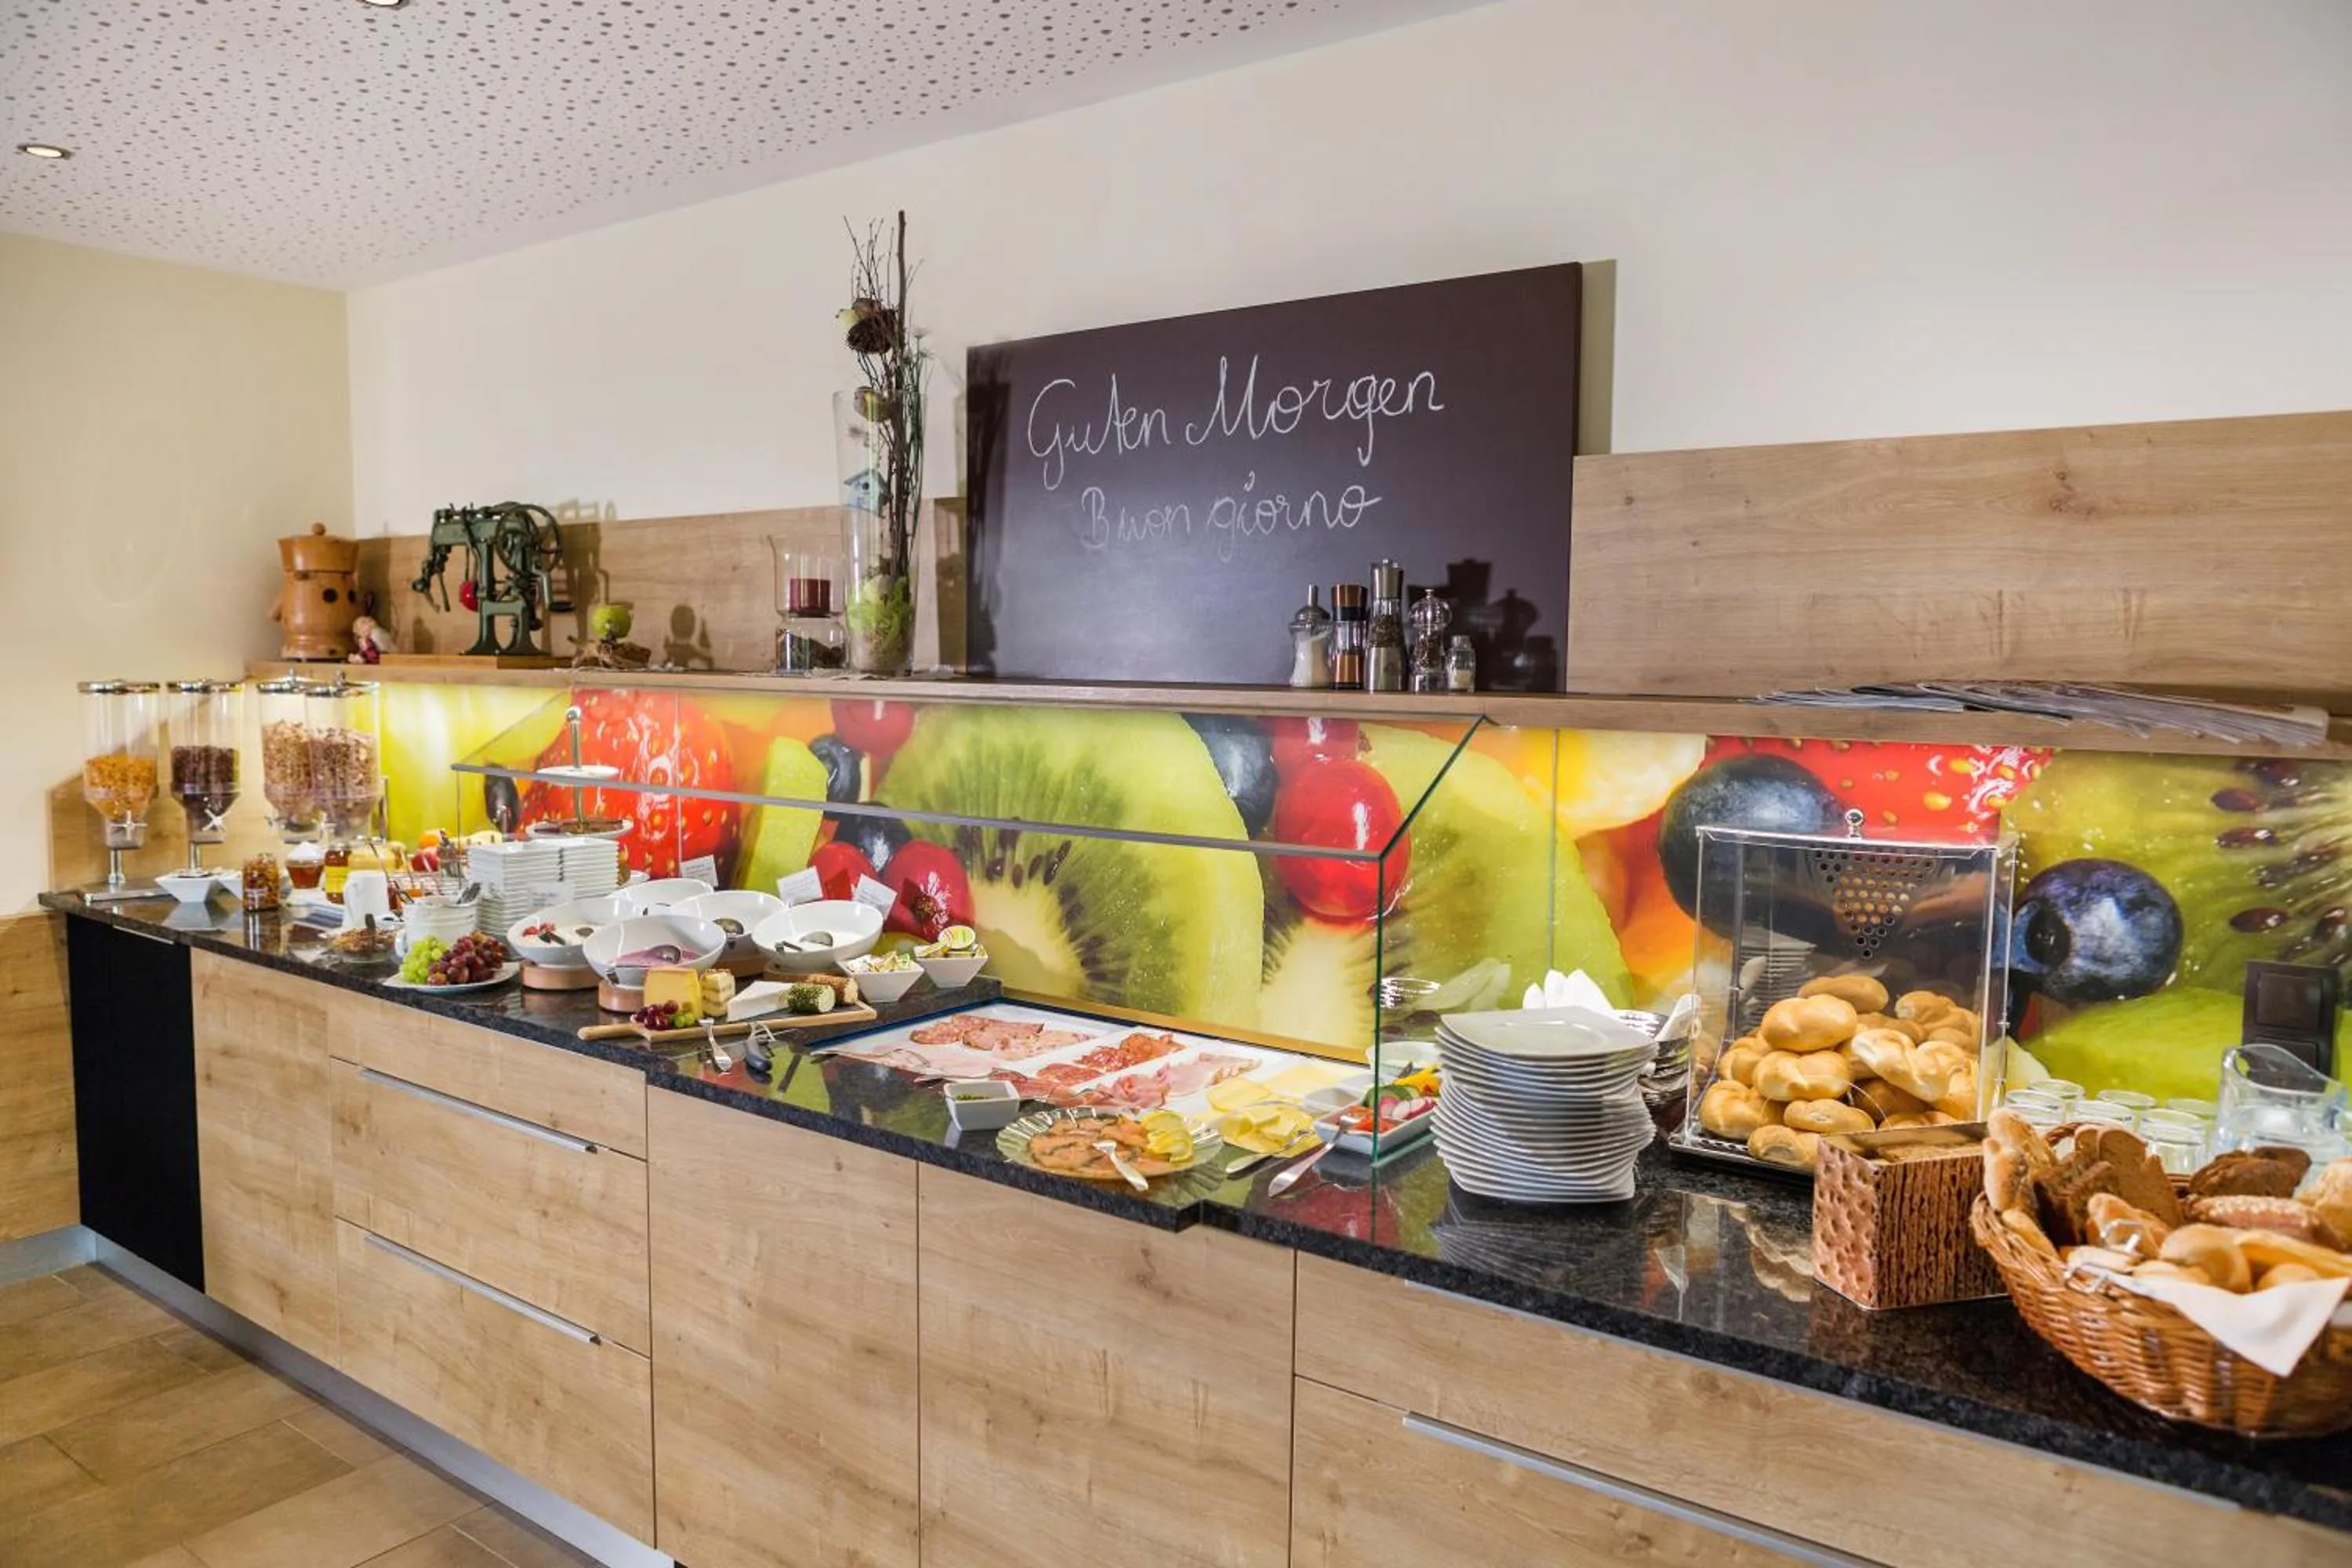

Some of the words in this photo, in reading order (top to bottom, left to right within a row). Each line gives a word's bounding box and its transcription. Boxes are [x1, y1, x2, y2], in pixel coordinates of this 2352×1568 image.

[1027, 373, 1171, 491] Guten
[1185, 354, 1445, 466] Morgen
[1080, 485, 1191, 549] Buon
[1205, 470, 1382, 563] giorno
